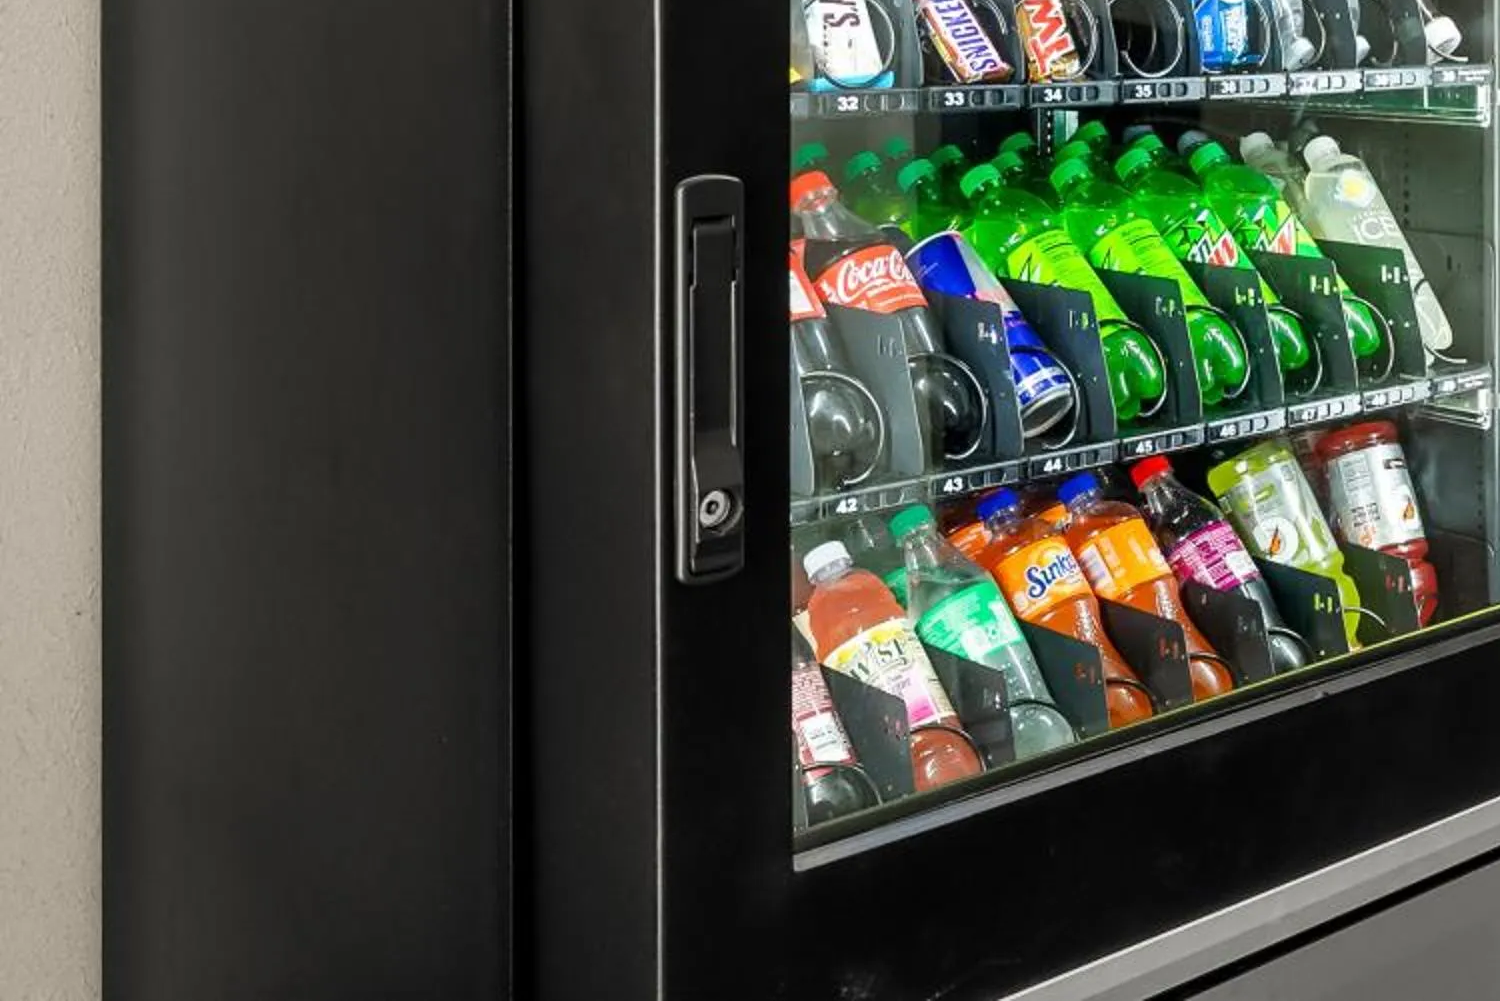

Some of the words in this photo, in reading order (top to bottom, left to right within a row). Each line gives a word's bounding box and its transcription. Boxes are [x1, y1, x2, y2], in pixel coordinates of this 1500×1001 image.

[1044, 89, 1063, 101] 34
[1135, 84, 1153, 97] 35
[838, 96, 859, 111] 32
[944, 93, 965, 106] 33
[1220, 424, 1236, 439] 46
[1136, 441, 1153, 454] 45
[1044, 459, 1063, 472] 44
[944, 478, 964, 492] 43
[836, 498, 859, 513] 42
